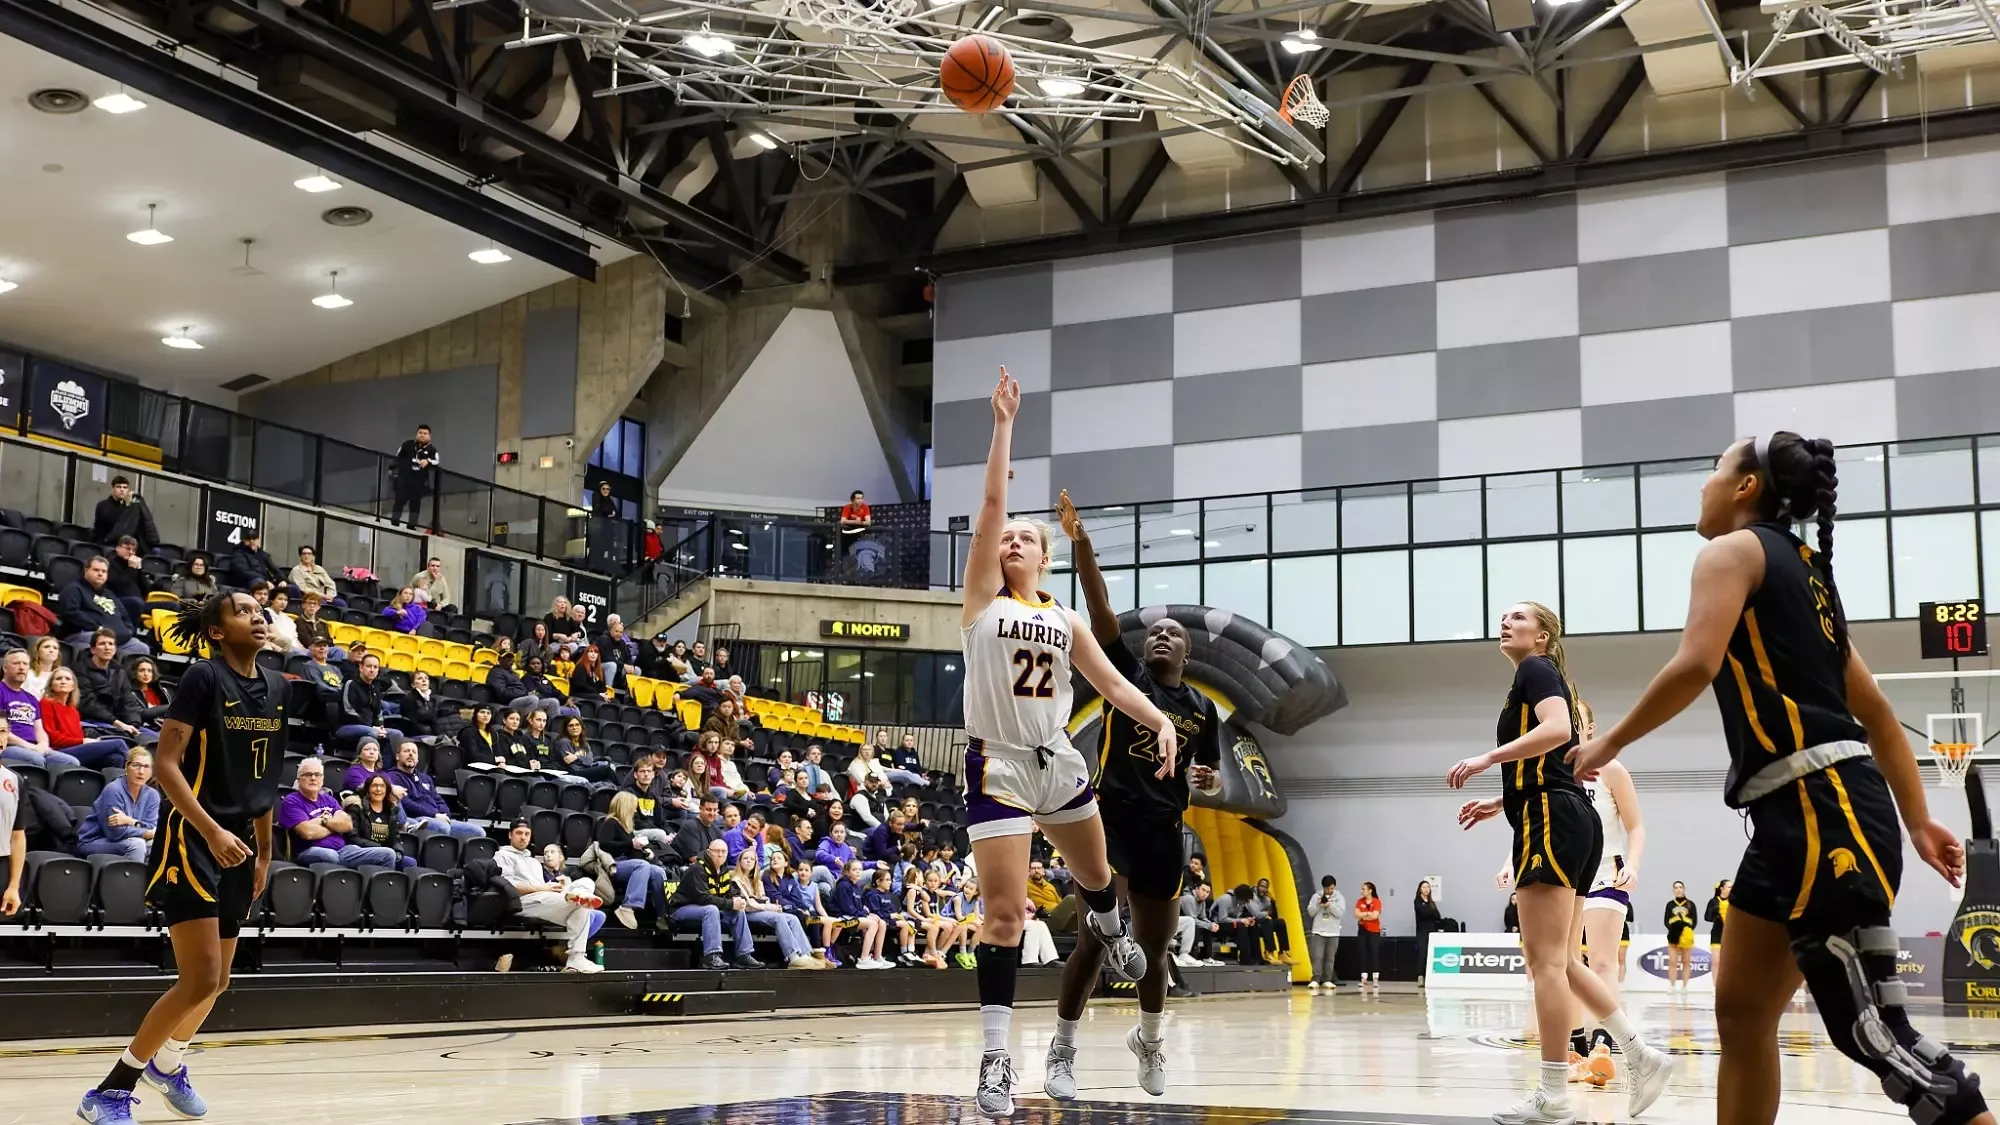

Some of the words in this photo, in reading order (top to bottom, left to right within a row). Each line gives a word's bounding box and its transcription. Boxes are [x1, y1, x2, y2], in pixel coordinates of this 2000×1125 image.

[216, 510, 256, 530] SECTION
[227, 526, 242, 545] 4
[578, 591, 607, 607] SECTION
[587, 604, 597, 623] 2
[1936, 603, 1979, 623] 8:22
[851, 623, 900, 637] NORTH
[1946, 622, 1973, 652] 10
[1013, 647, 1054, 698] 22
[251, 737, 269, 779] 1
